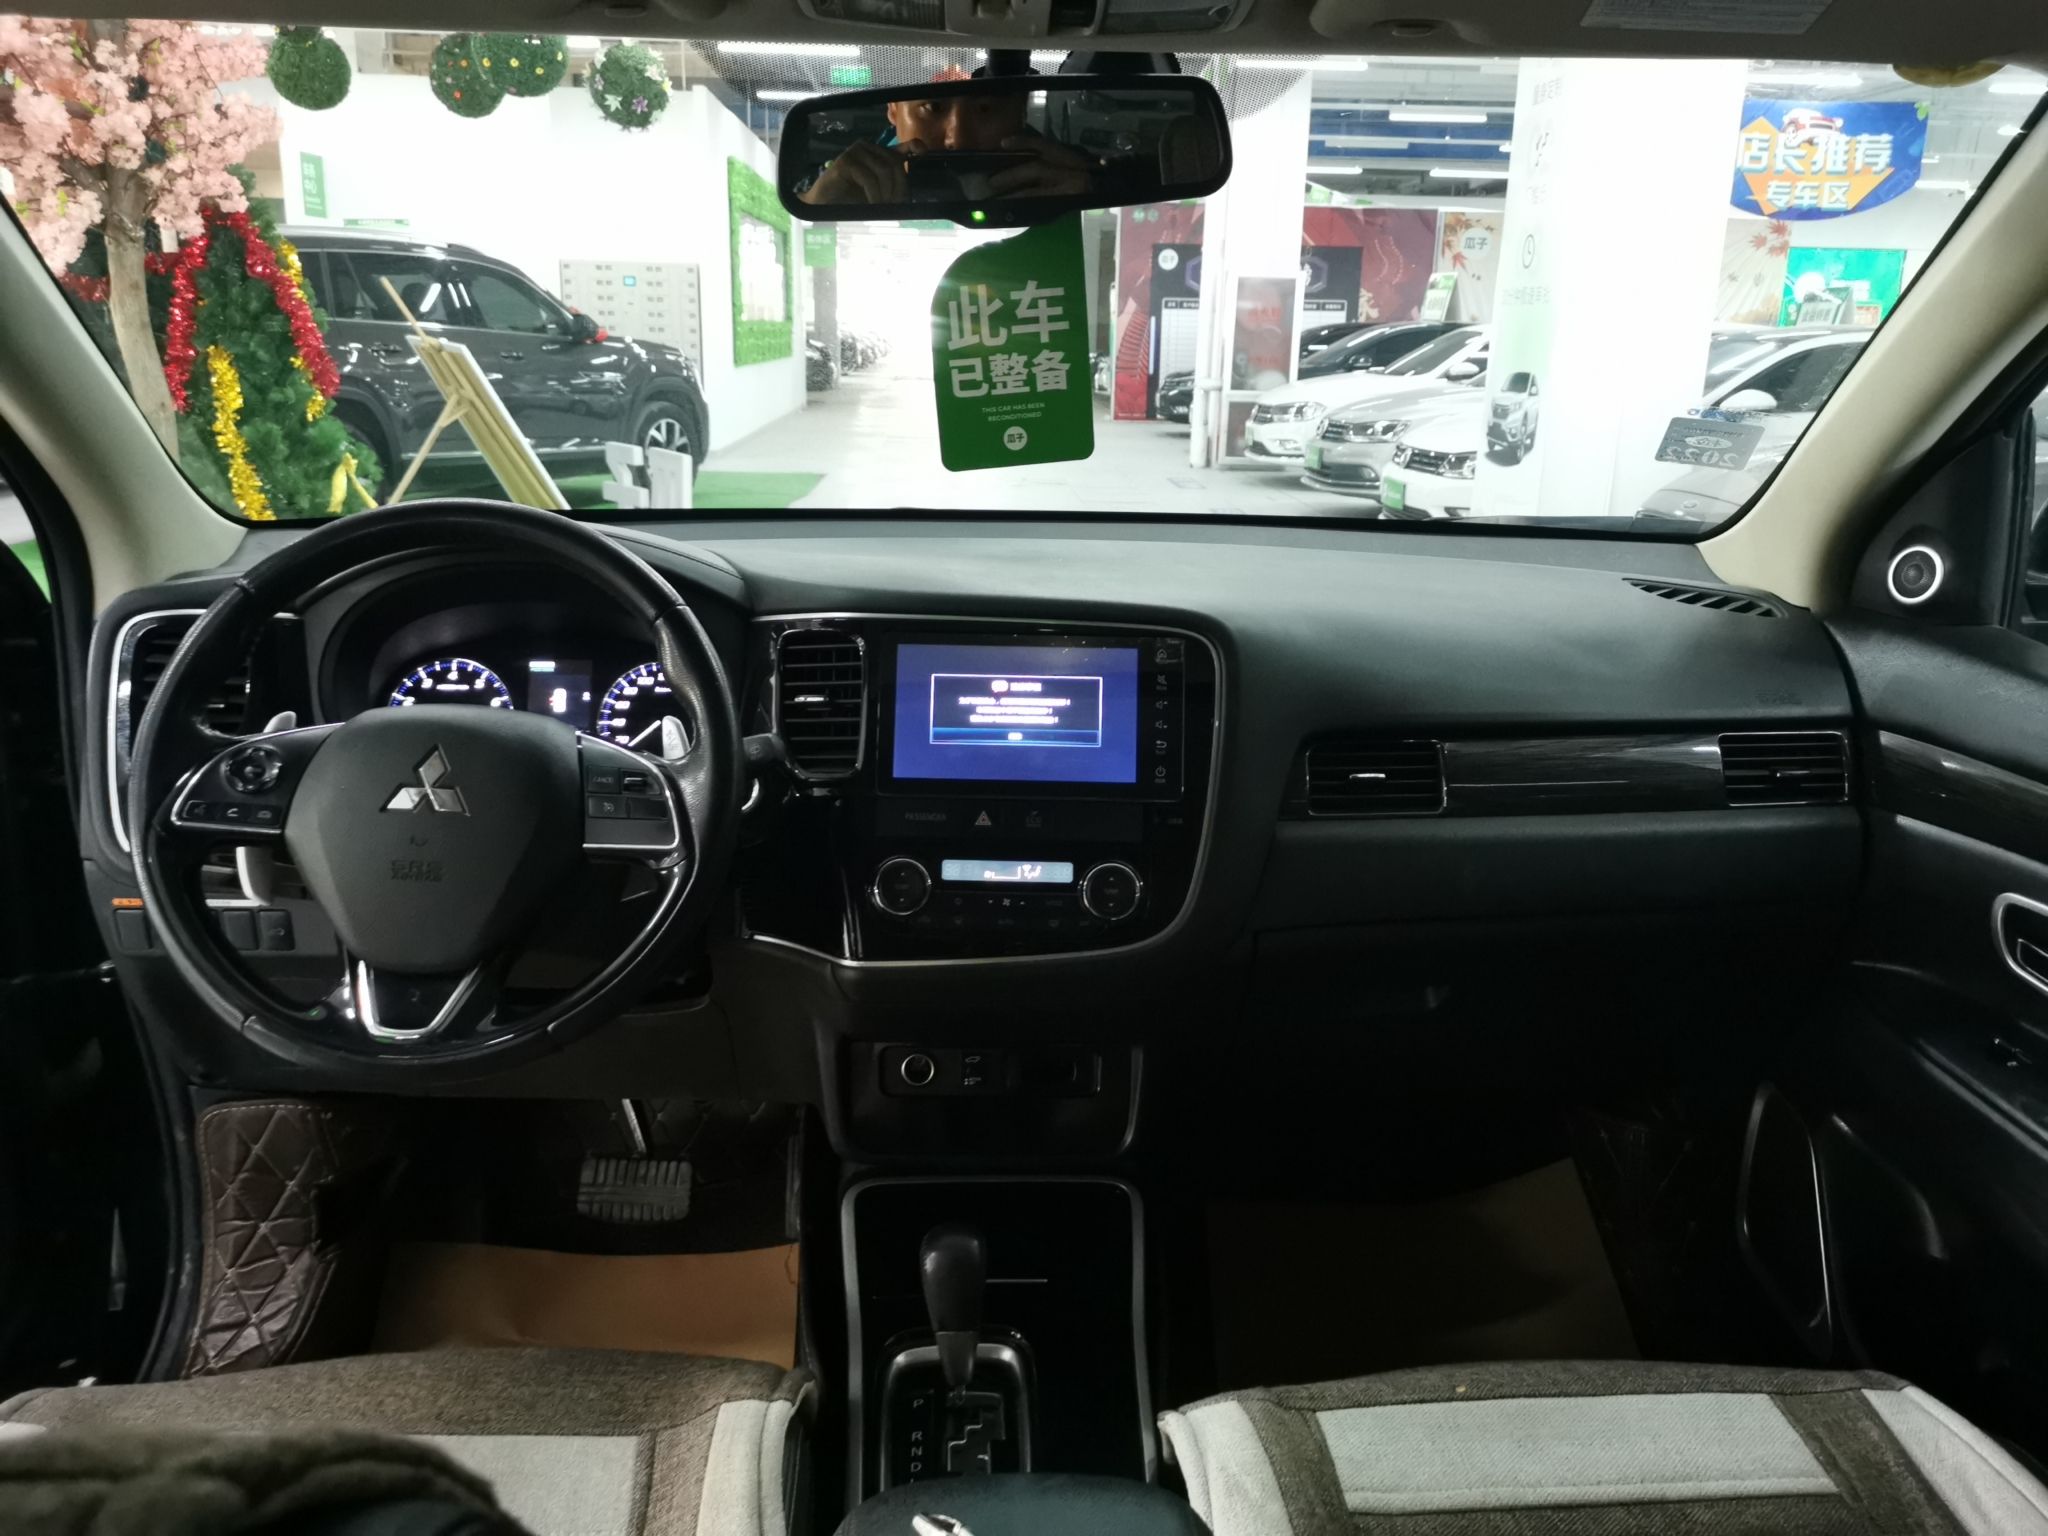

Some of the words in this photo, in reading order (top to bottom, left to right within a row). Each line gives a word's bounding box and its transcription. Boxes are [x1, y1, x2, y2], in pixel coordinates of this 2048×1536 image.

[1737, 131, 1894, 175] 店长推荐
[1766, 180, 1851, 212] 专车区
[1463, 236, 1488, 250] 瓜子
[947, 280, 1070, 351] 此车
[949, 349, 1071, 398] 已整备
[1012, 403, 1026, 411] HAS
[987, 411, 1042, 422] RECONDITIONED
[1006, 432, 1025, 444] 瓜子
[911, 1430, 923, 1441] R
[911, 1446, 923, 1456] N
[910, 1461, 922, 1472] D
